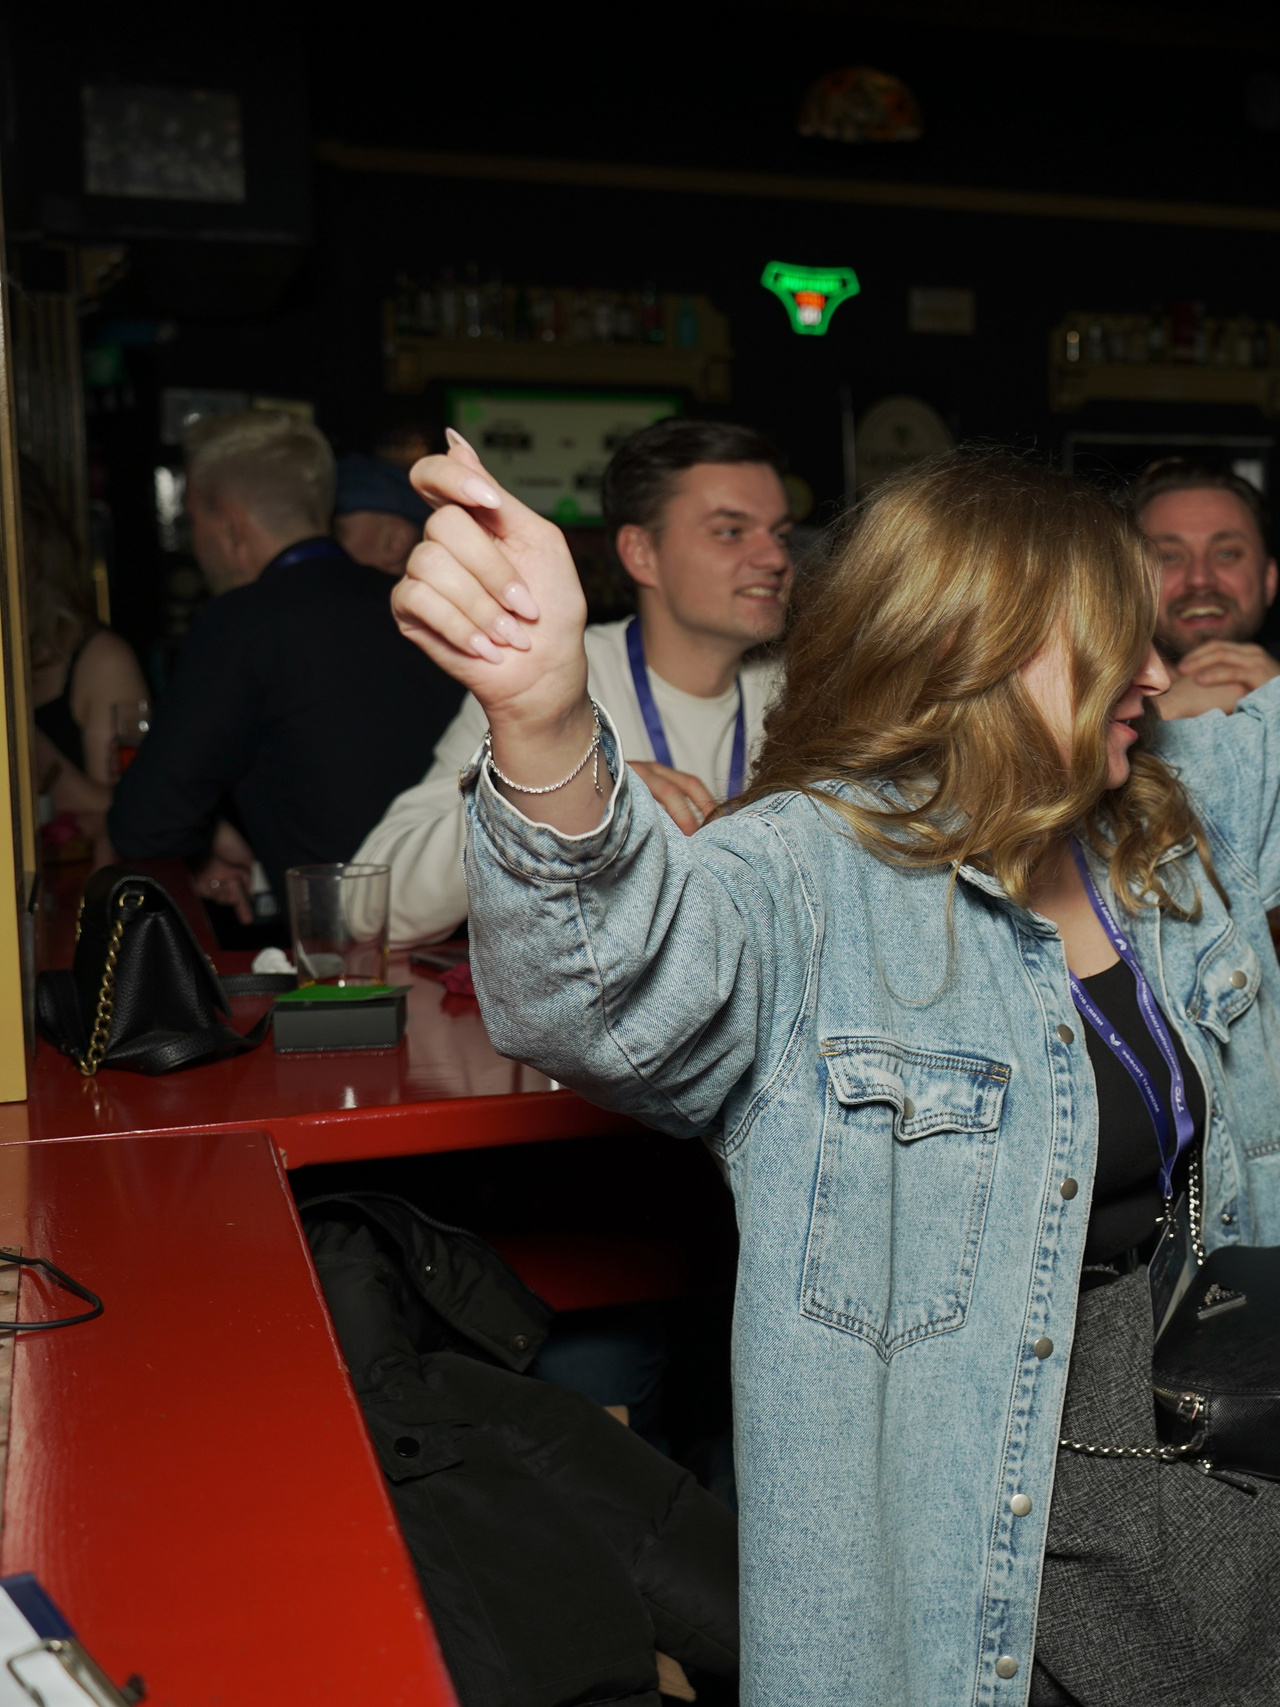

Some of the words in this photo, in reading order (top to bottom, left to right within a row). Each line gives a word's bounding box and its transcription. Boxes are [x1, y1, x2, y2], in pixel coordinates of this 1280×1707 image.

[1070, 979, 1087, 1005] ТОРОВ
[1085, 1004, 1104, 1026] СВЯЗИ
[1121, 1050, 1144, 1078] ЭФФОРТ
[1142, 1078, 1160, 1113] ТЕЛЕКОМ
